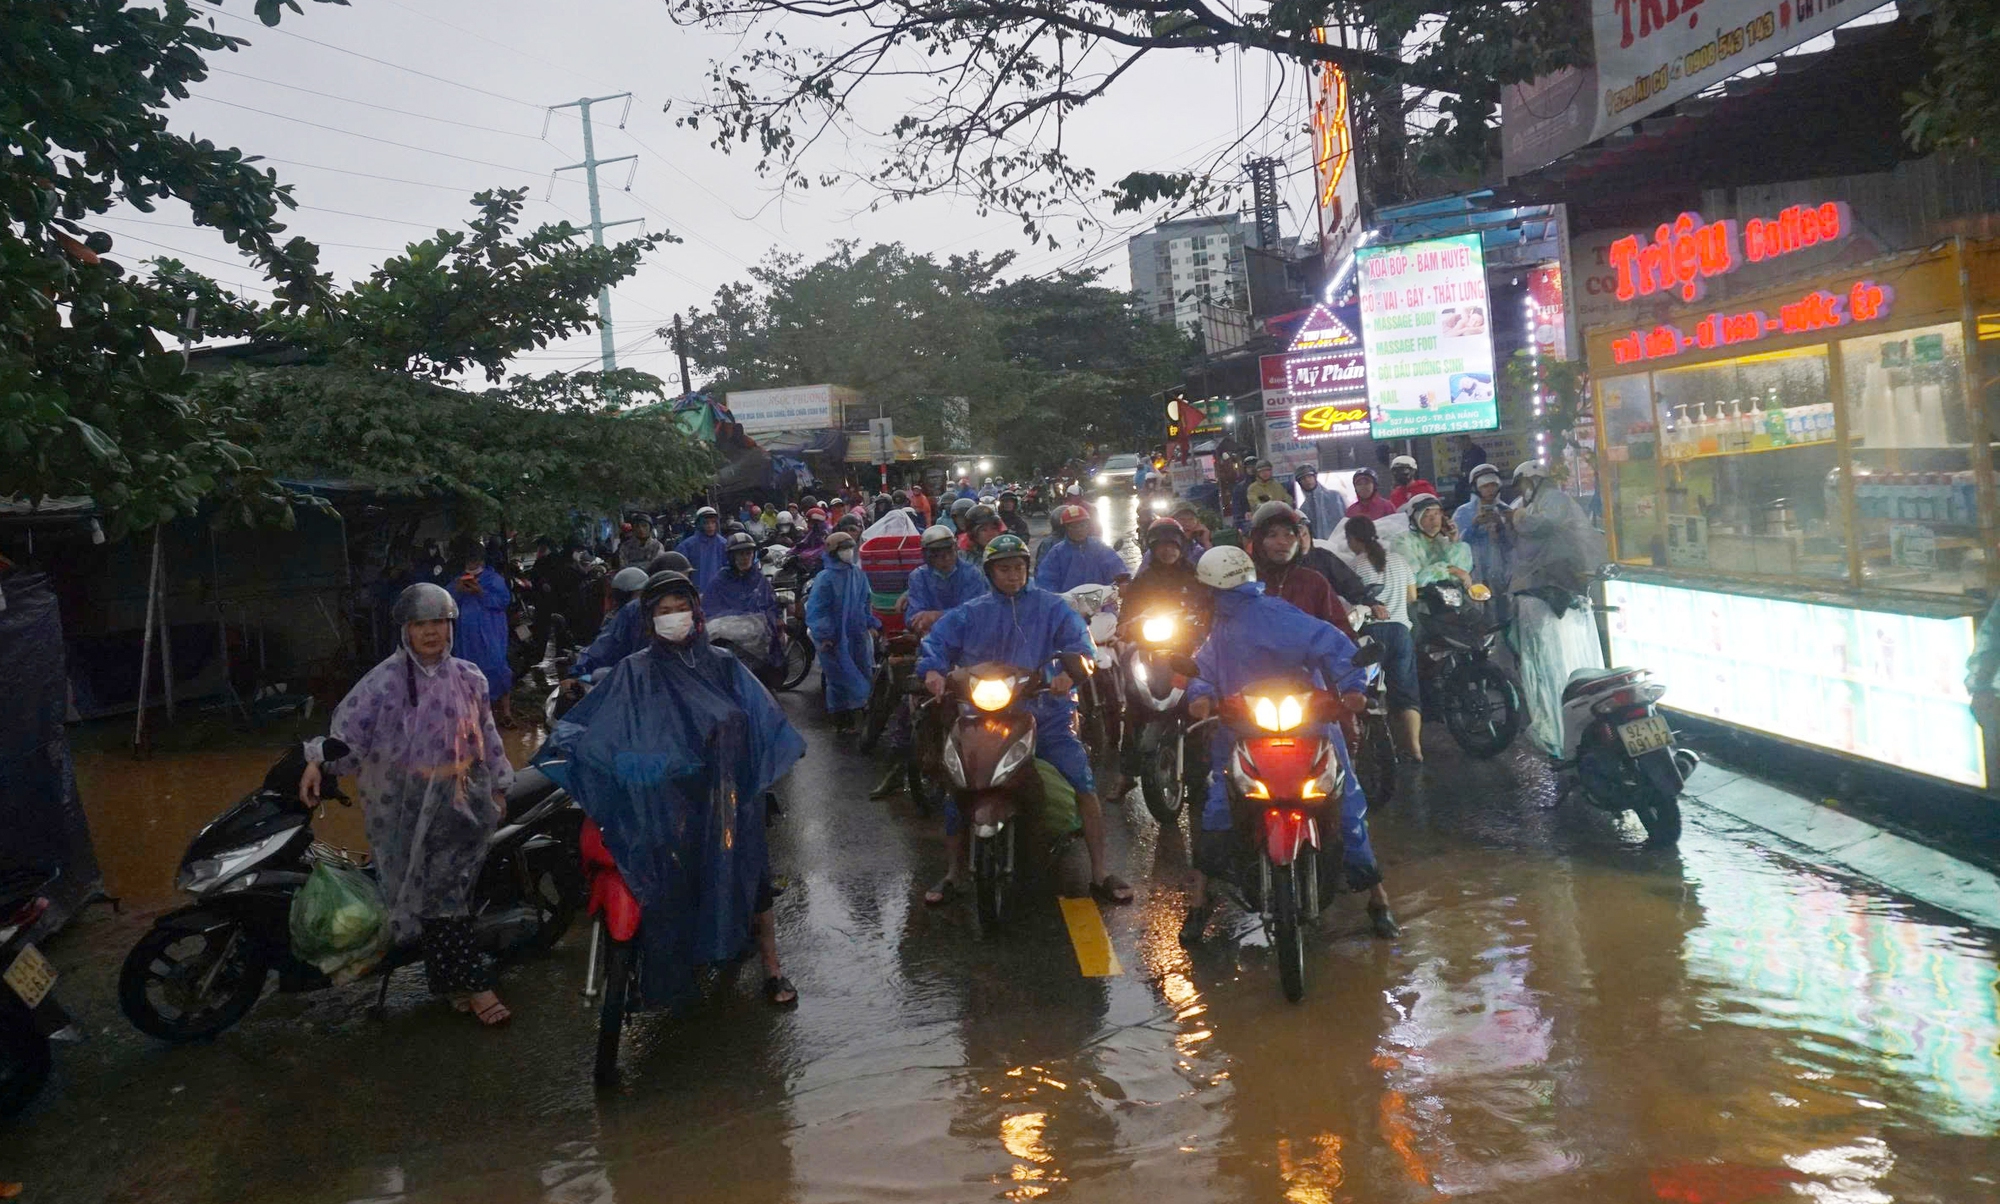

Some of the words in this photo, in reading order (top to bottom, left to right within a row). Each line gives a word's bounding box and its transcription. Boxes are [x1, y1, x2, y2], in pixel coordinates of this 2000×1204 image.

[1685, 42, 1717, 77] 0908
[1718, 30, 1744, 60] 543
[1745, 11, 1775, 47] 143
[1610, 212, 1732, 301] Triệu
[1746, 201, 1840, 262] Coffee
[1383, 291, 1398, 310] VAI
[1406, 284, 1424, 308] GÁY
[1374, 314, 1413, 332] MASSAGE
[1415, 311, 1436, 327] BODY
[1376, 338, 1415, 356] MASSAGE
[1417, 336, 1438, 352] FOOT
[1295, 366, 1319, 387] Mỹ
[1443, 358, 1464, 374] SINH
[1379, 389, 1399, 405] NAIL
[1297, 406, 1368, 431] Spa
